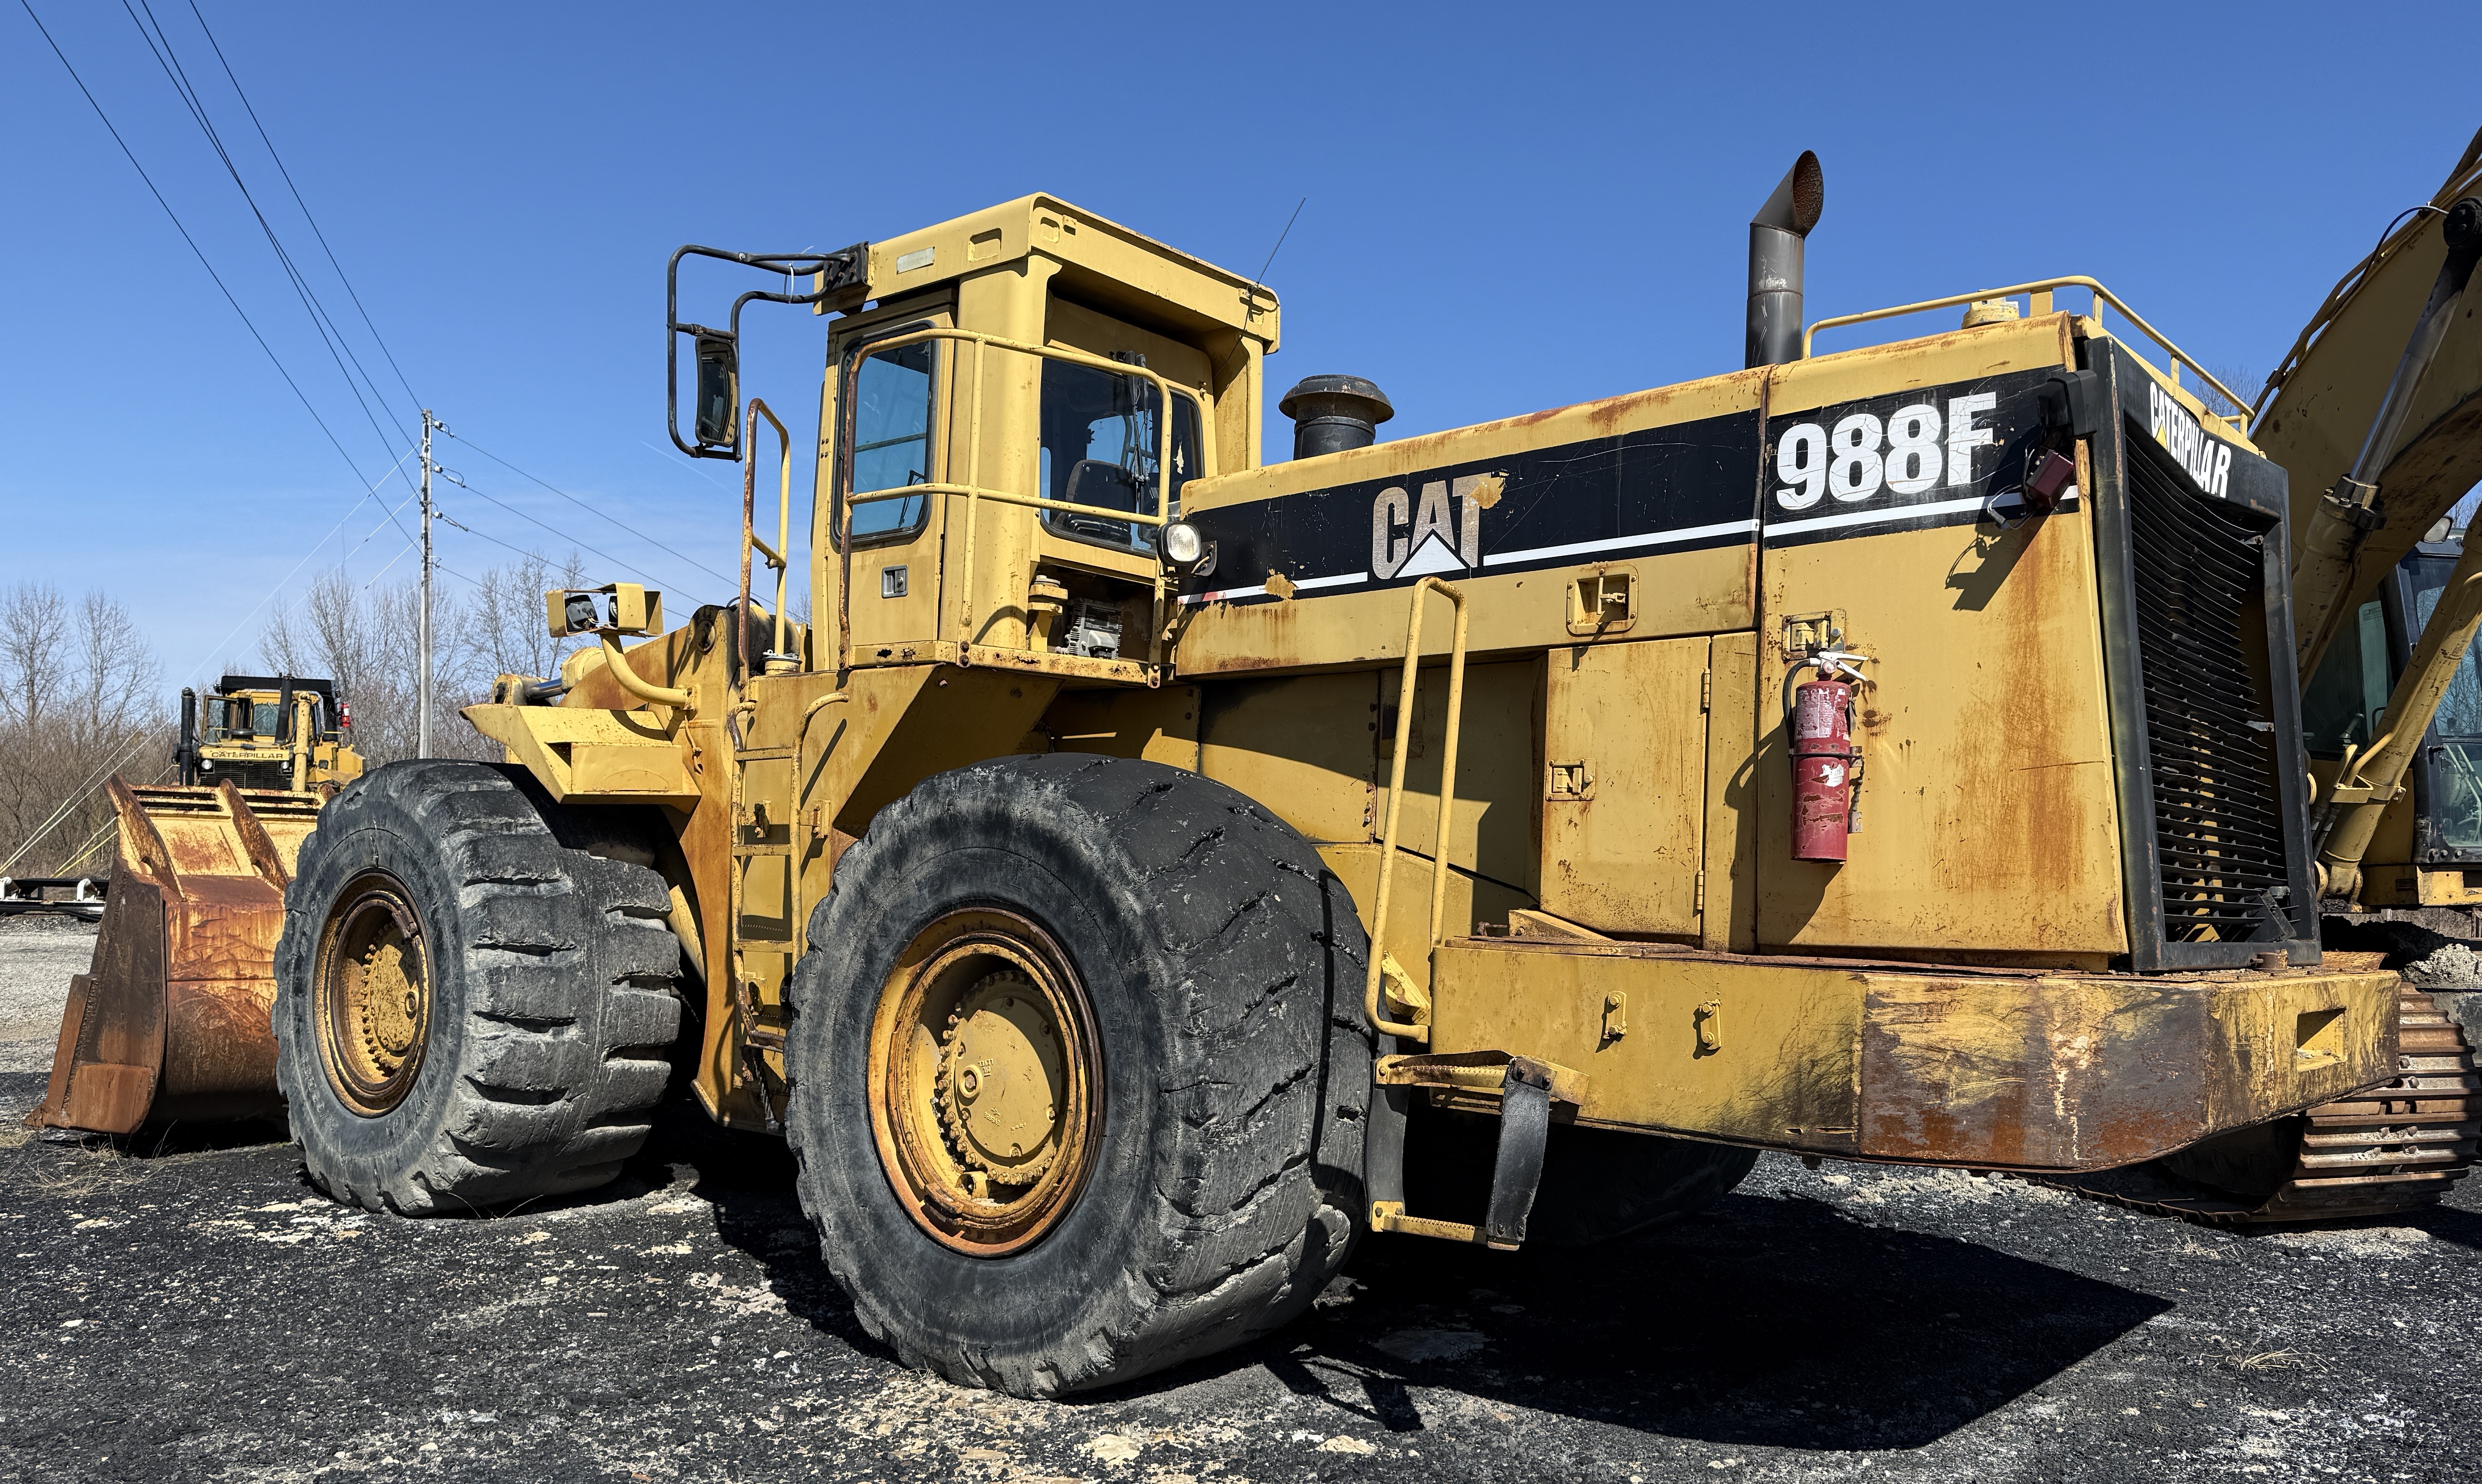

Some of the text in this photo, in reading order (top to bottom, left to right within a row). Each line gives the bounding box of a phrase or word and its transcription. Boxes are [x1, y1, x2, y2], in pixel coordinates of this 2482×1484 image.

[1776, 391, 1996, 510] 988F
[2150, 381, 2232, 498] CATERPILLAR
[1372, 472, 1492, 580] CAT
